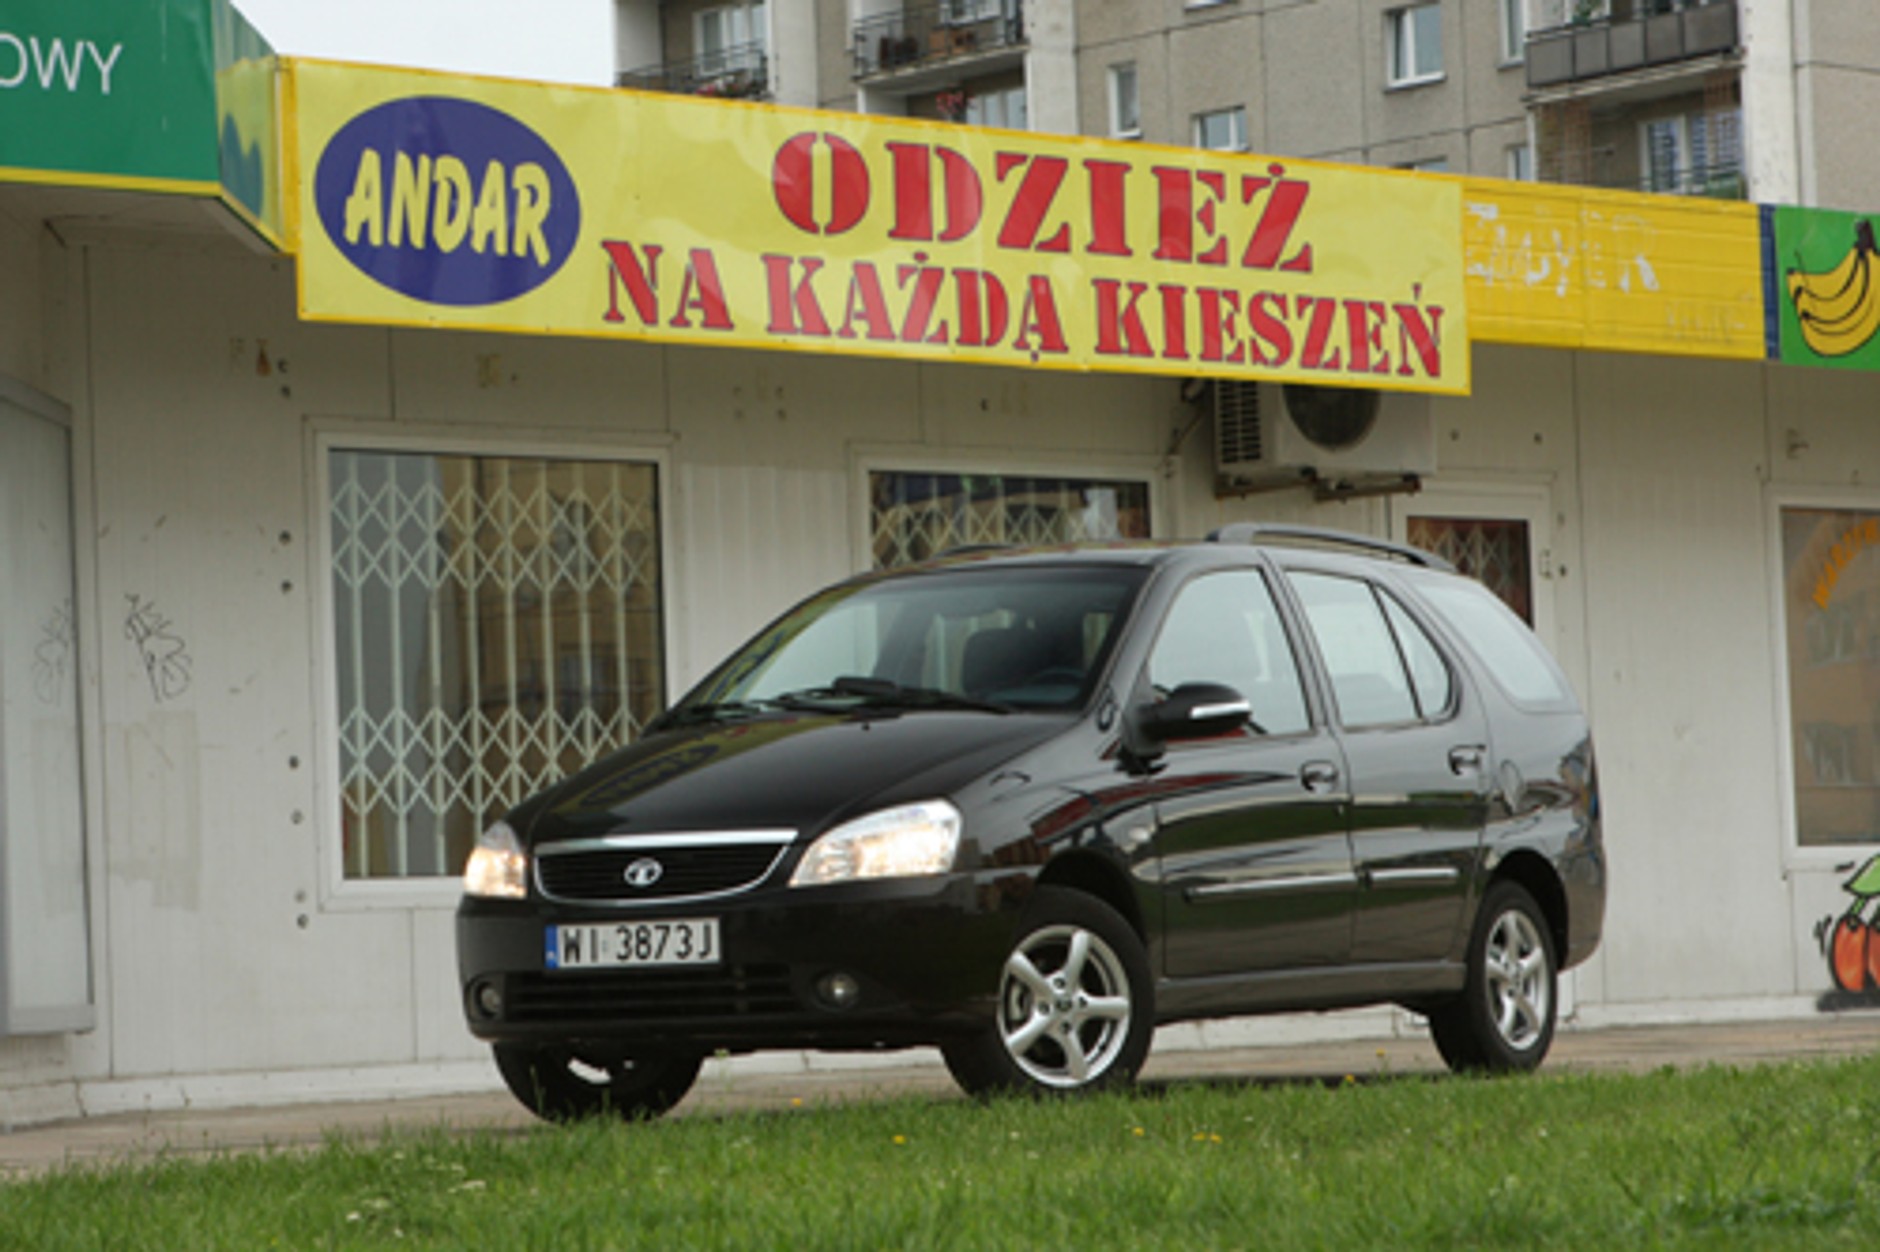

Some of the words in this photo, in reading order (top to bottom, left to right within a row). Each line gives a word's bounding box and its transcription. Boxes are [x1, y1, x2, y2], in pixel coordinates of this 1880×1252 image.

[344, 147, 551, 268] ANDAR
[771, 130, 1313, 274] ODZIEŻ
[601, 240, 734, 330] NA
[760, 251, 1070, 363] KAŻDĄ
[1091, 278, 1444, 379] KIESZEŃ
[562, 926, 599, 964] WI
[615, 922, 712, 962] 3873J
